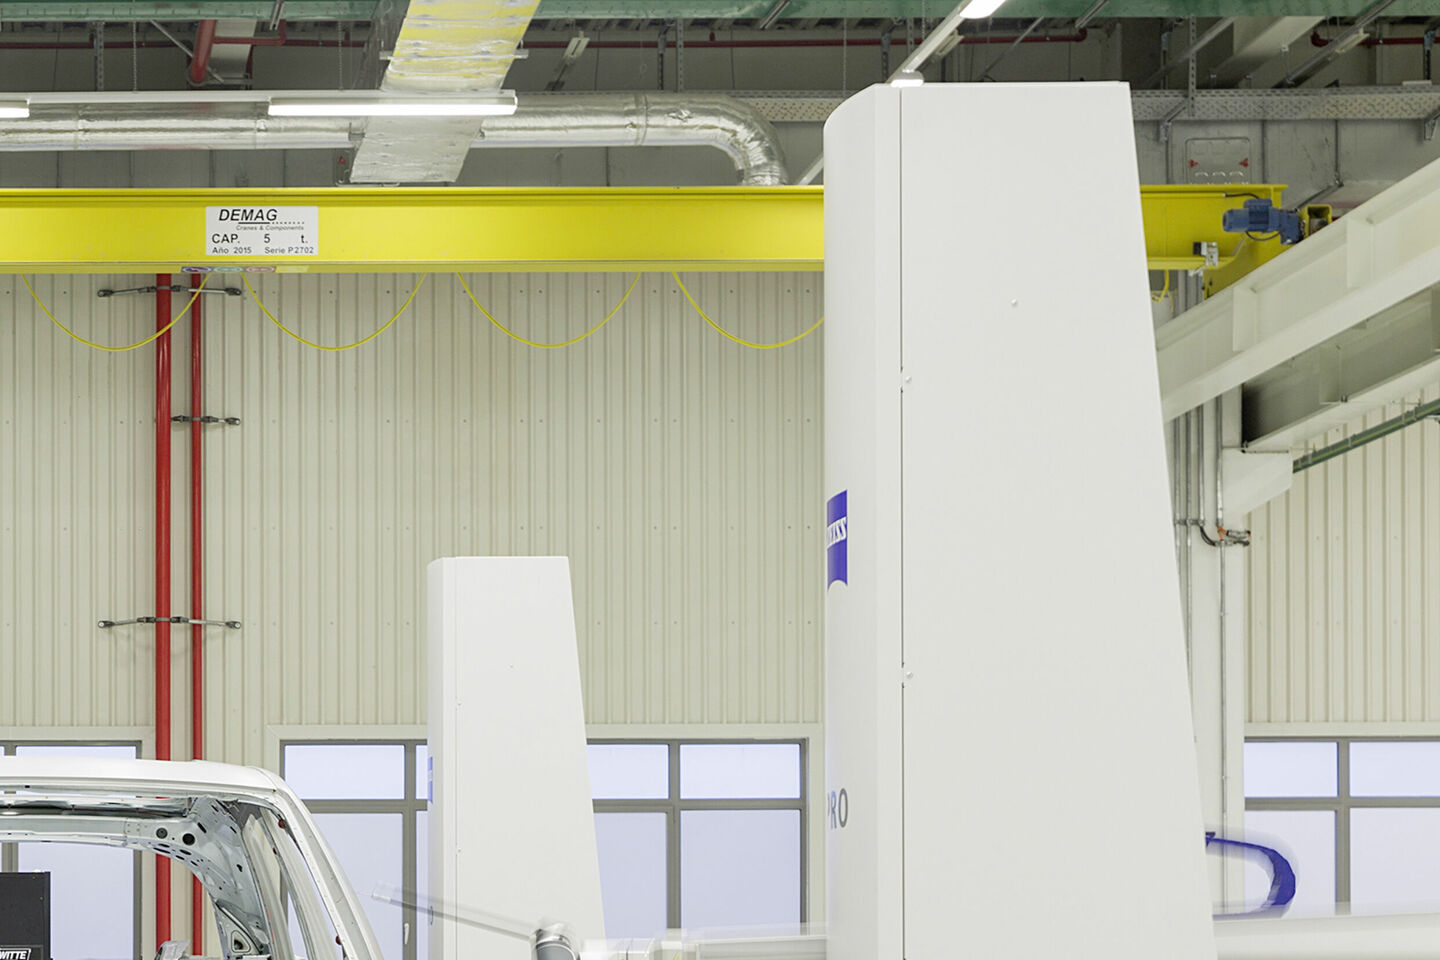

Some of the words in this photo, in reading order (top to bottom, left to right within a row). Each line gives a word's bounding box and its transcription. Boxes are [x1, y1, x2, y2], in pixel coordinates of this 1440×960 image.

[218, 208, 279, 221] DEMAG
[211, 233, 241, 244] CAP.
[263, 233, 271, 244] 5
[300, 234, 309, 244] t.
[211, 246, 230, 254] Año
[233, 246, 252, 254] 2015
[264, 246, 286, 254] Serie
